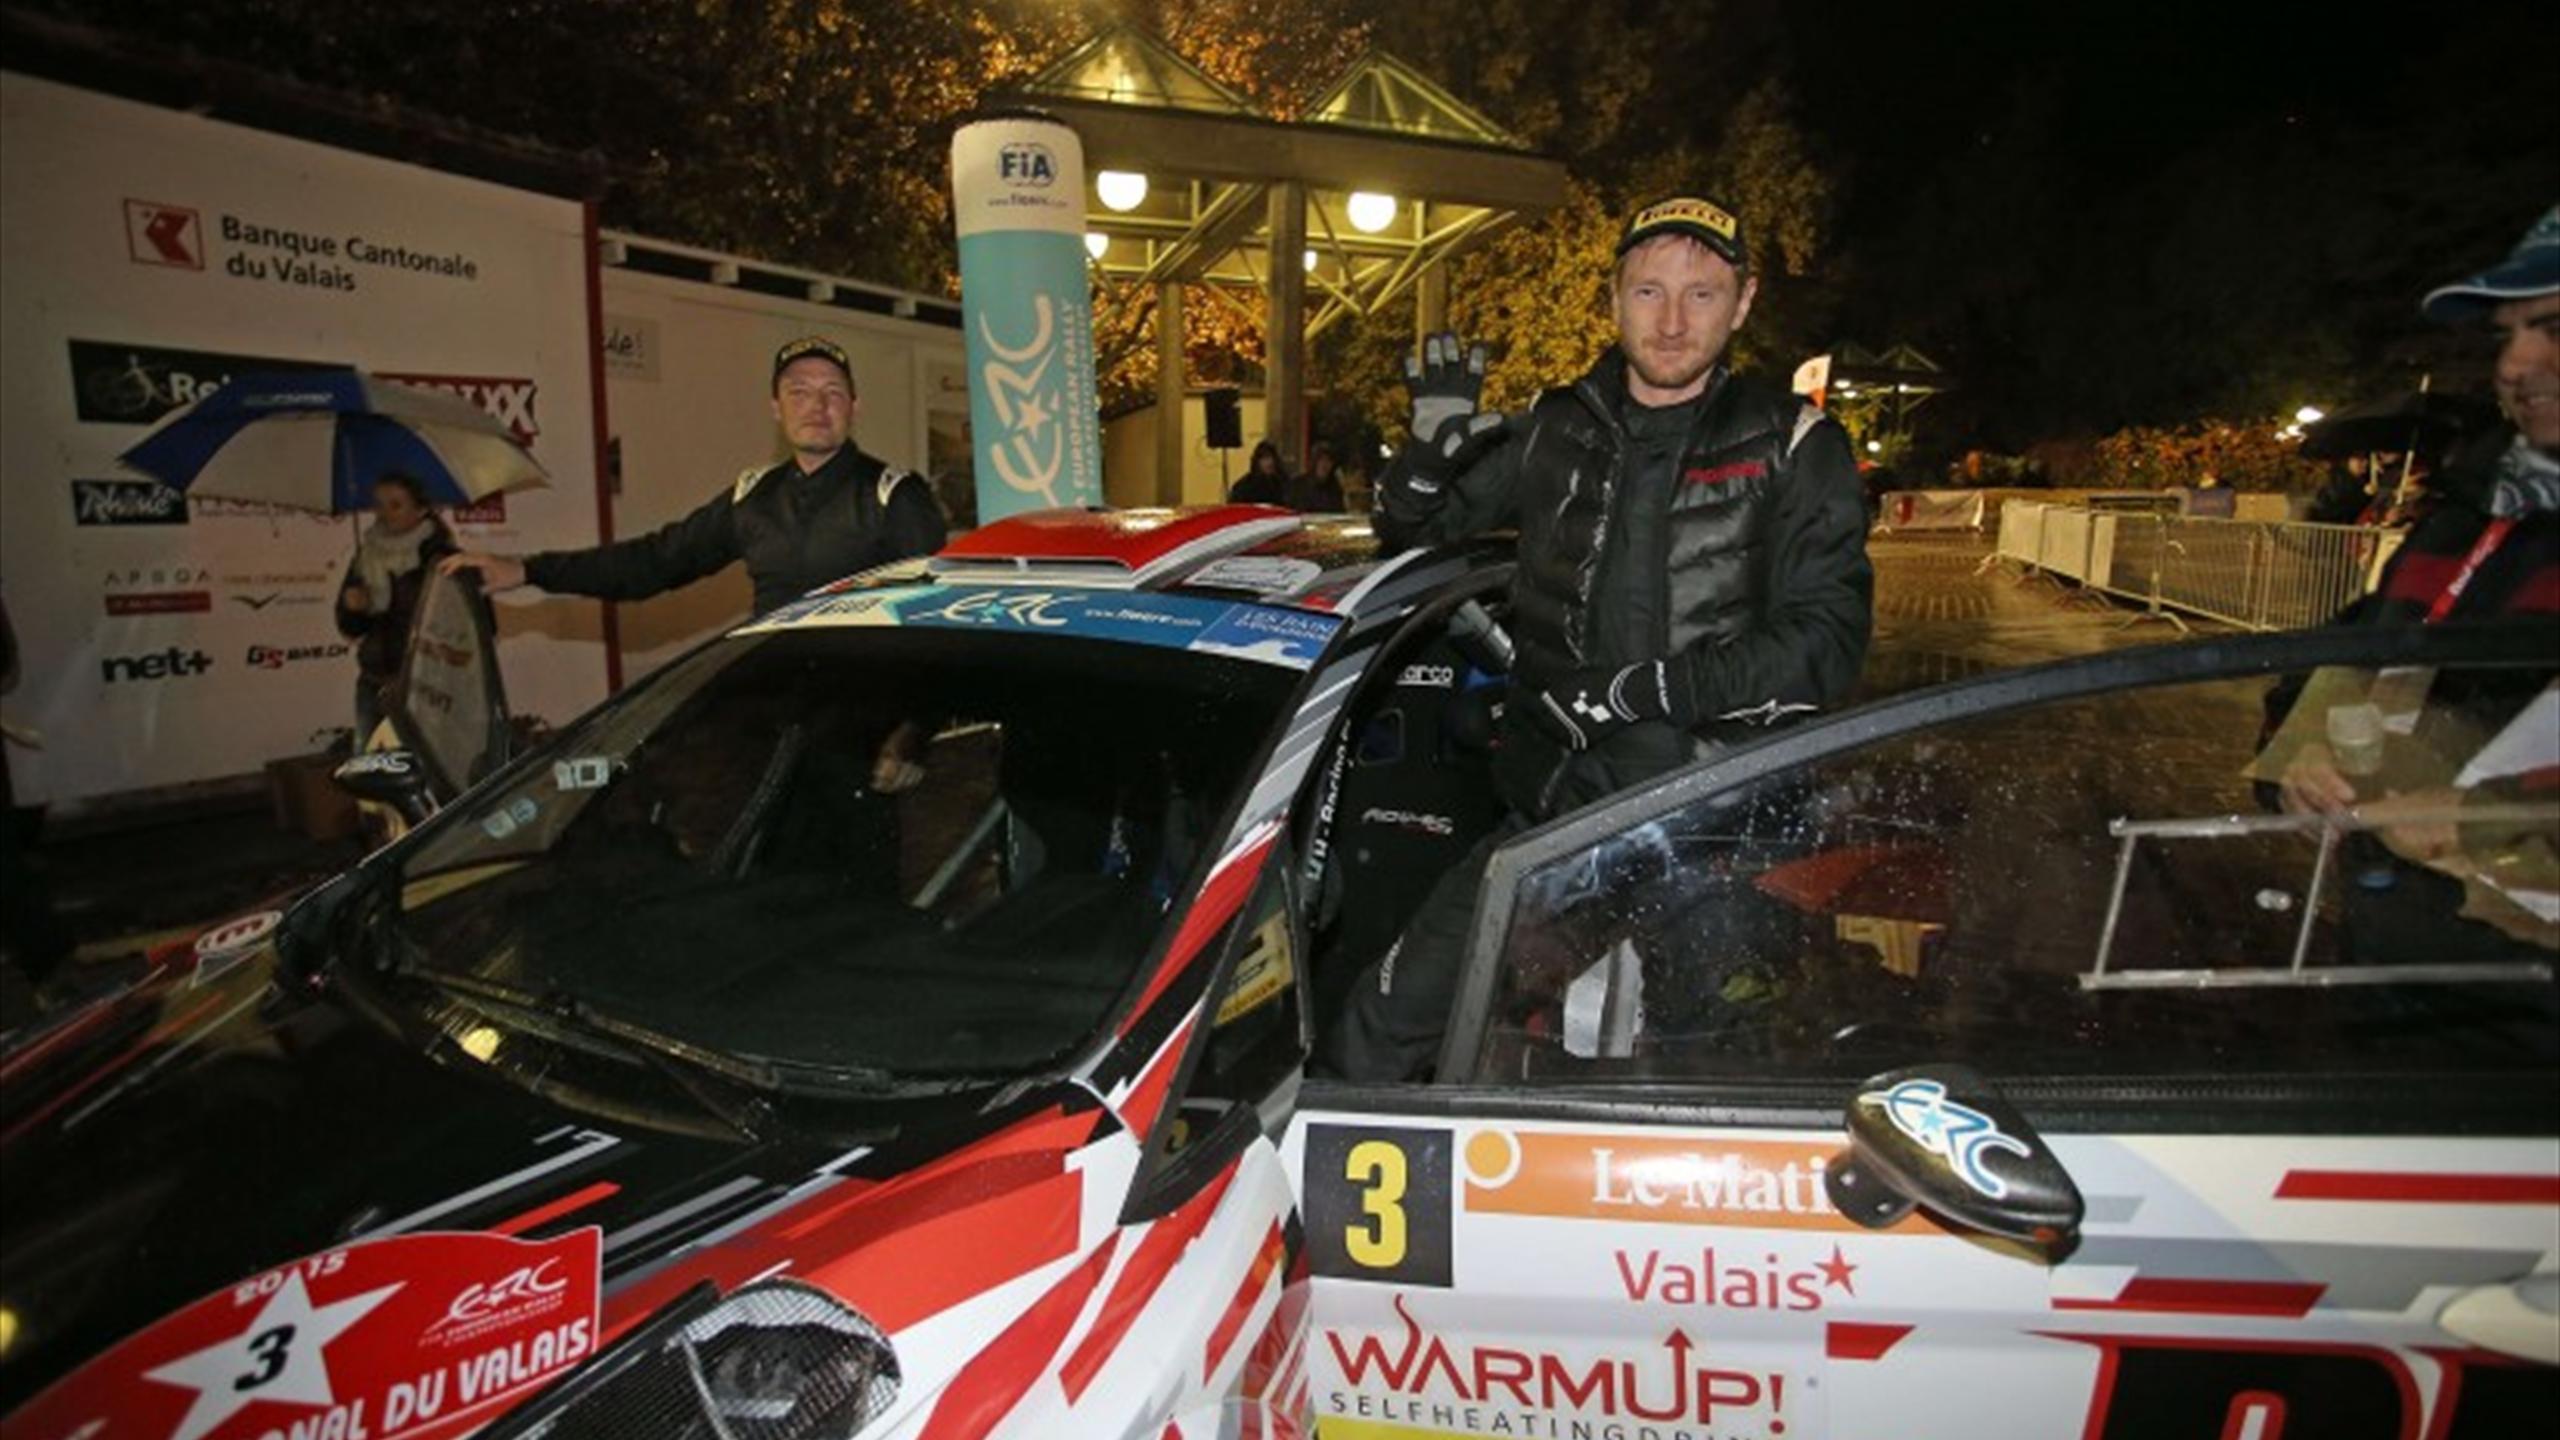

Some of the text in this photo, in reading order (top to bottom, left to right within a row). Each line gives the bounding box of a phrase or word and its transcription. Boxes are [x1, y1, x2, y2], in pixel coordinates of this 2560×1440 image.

[221, 215, 477, 281] Banque Cantonale
[227, 252, 355, 291] du Valais
[1061, 300, 1079, 369] RALLY
[908, 591, 1088, 626] ERC
[103, 645, 212, 683] net+
[1344, 1140, 1407, 1269] 3
[1592, 1148, 1840, 1215] Le Mati
[1615, 1250, 1822, 1311] Valais
[234, 1325, 295, 1391] 3
[383, 1367, 448, 1430] DU
[455, 1317, 590, 1402] VALAIS
[1326, 1294, 1786, 1434] WARMUP!
[1330, 1391, 1752, 1440] SELFHEATINGD
